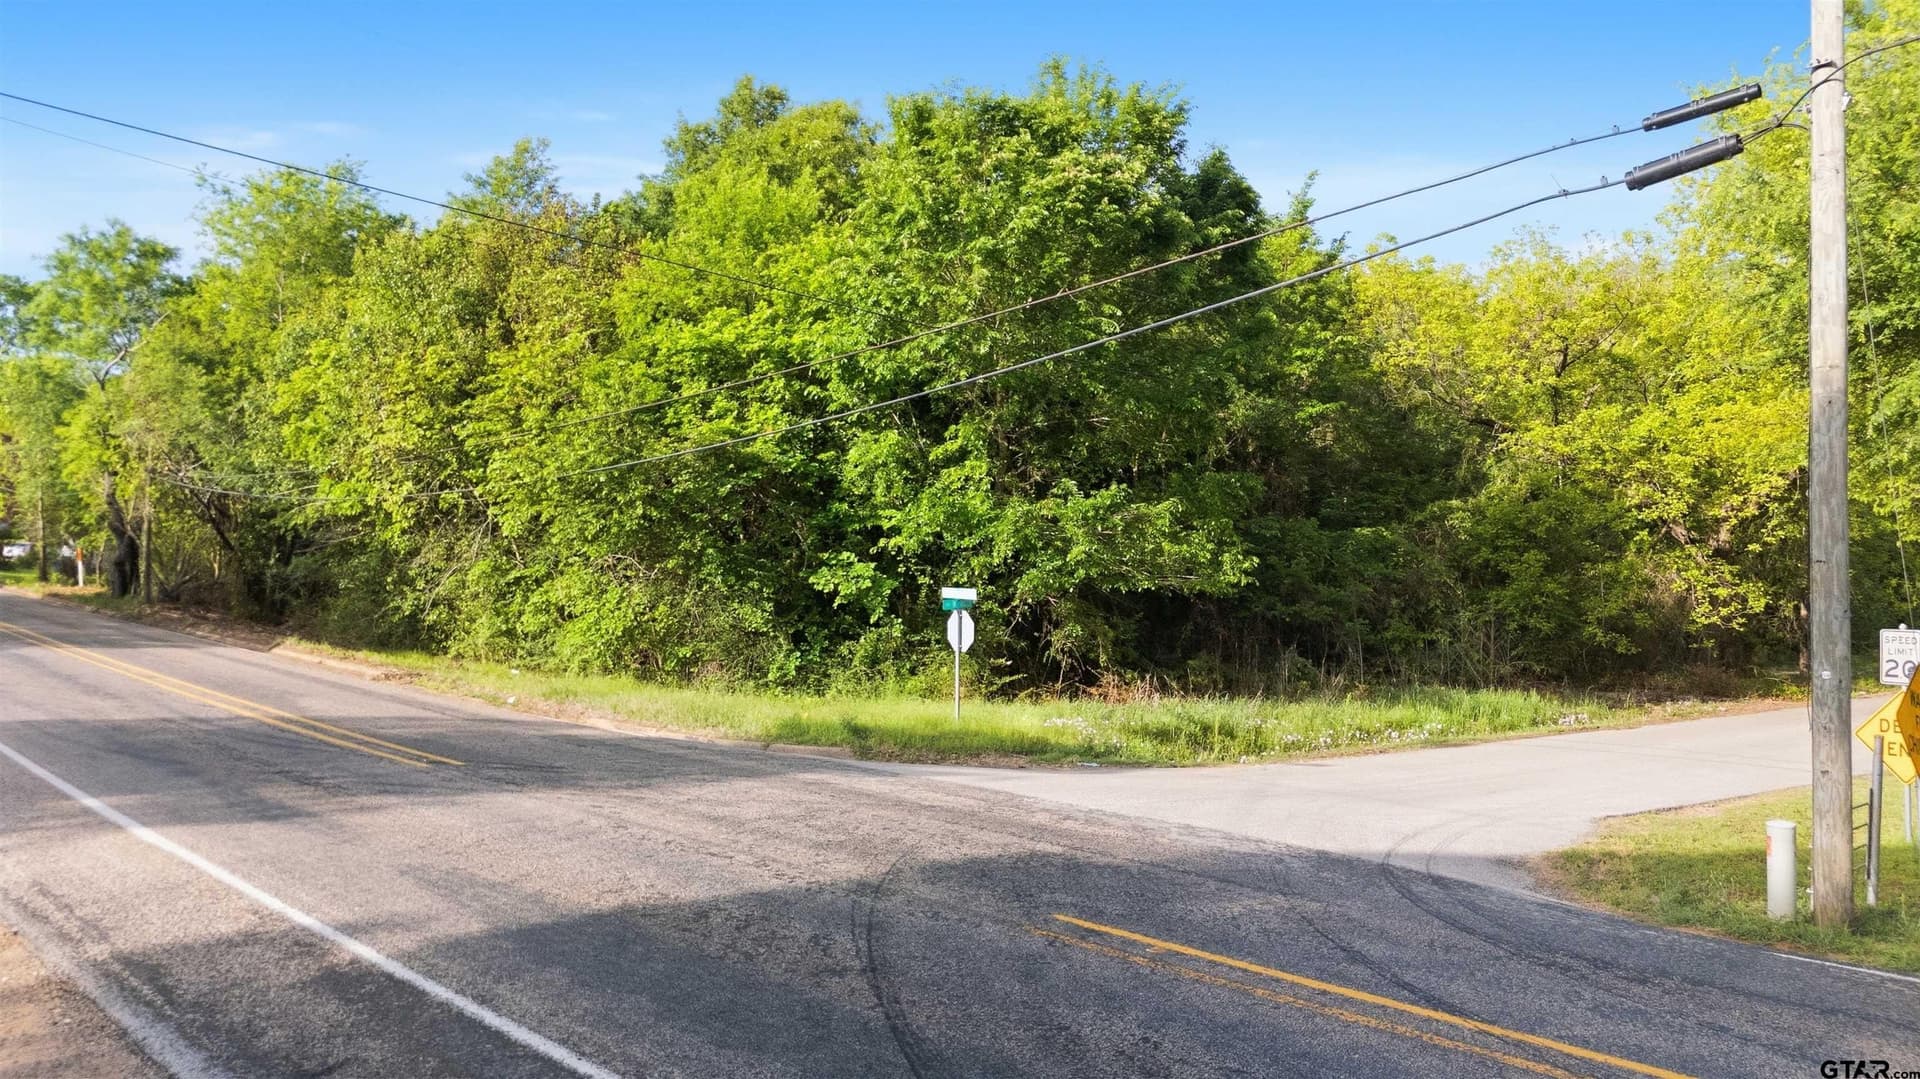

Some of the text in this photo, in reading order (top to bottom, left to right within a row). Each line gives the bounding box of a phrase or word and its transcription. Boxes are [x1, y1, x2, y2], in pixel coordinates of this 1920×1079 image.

[1884, 636, 1918, 645] SPEED
[1887, 647, 1913, 656] LIMIT
[1885, 659, 1917, 679] 20
[1880, 719, 1902, 733] DE
[1887, 742, 1909, 757] EN
